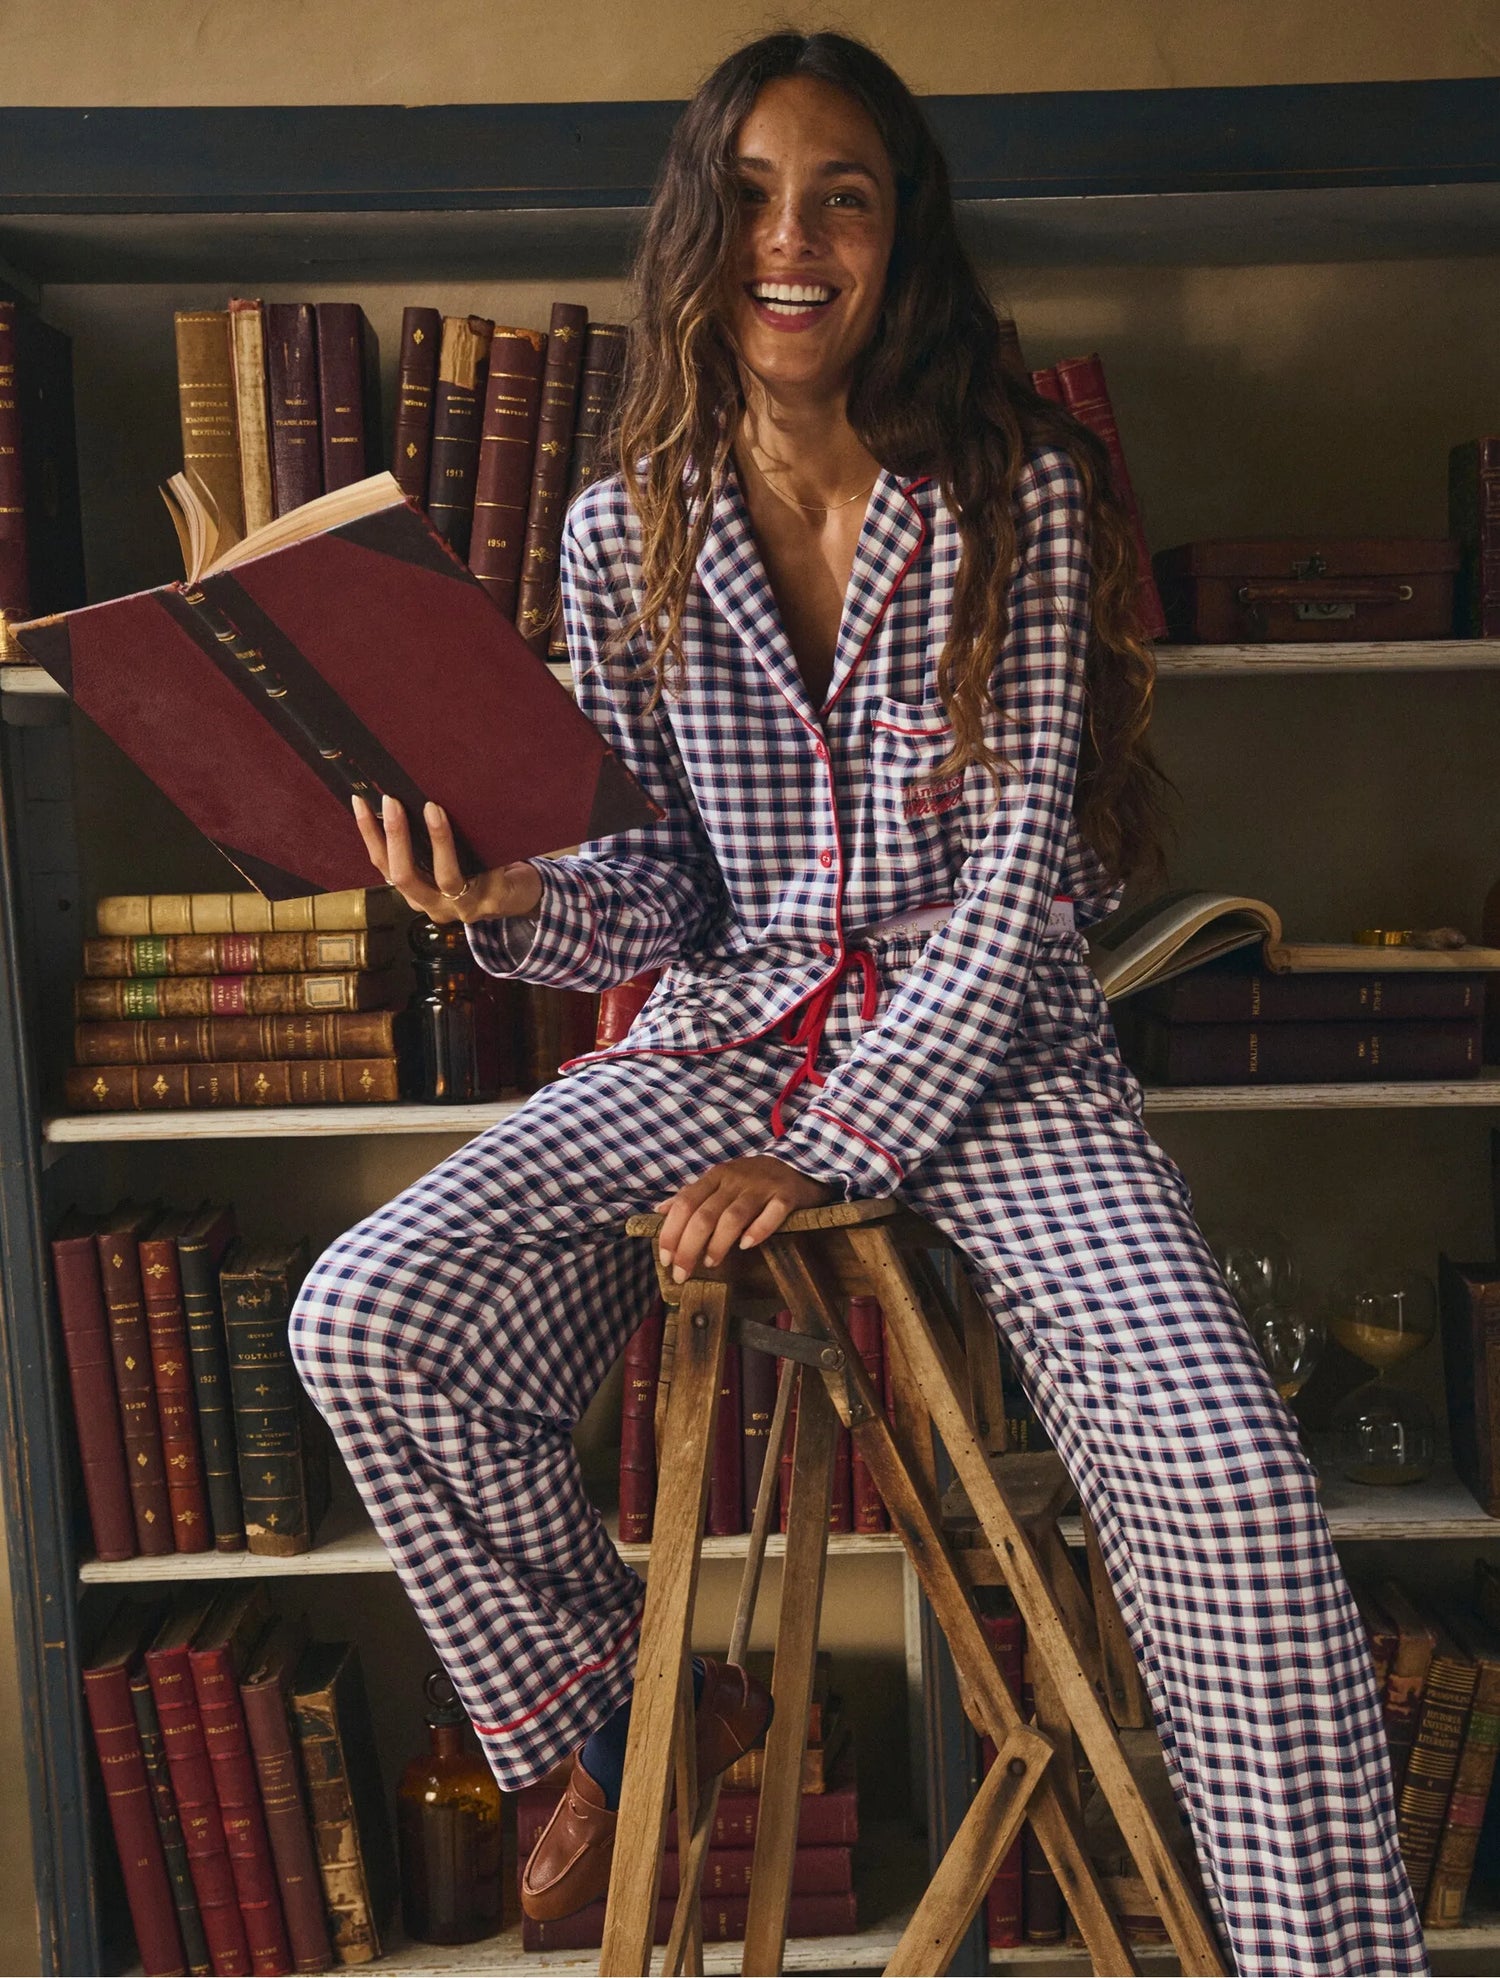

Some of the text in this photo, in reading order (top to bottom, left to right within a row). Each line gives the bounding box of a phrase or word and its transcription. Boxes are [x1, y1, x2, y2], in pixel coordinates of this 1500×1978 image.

[274, 419, 318, 427] TRANSLATION
[486, 538, 508, 549] 1950
[238, 1350, 286, 1361] VOLTAIRE
[1422, 1718, 1461, 1734] UNIVERSAL
